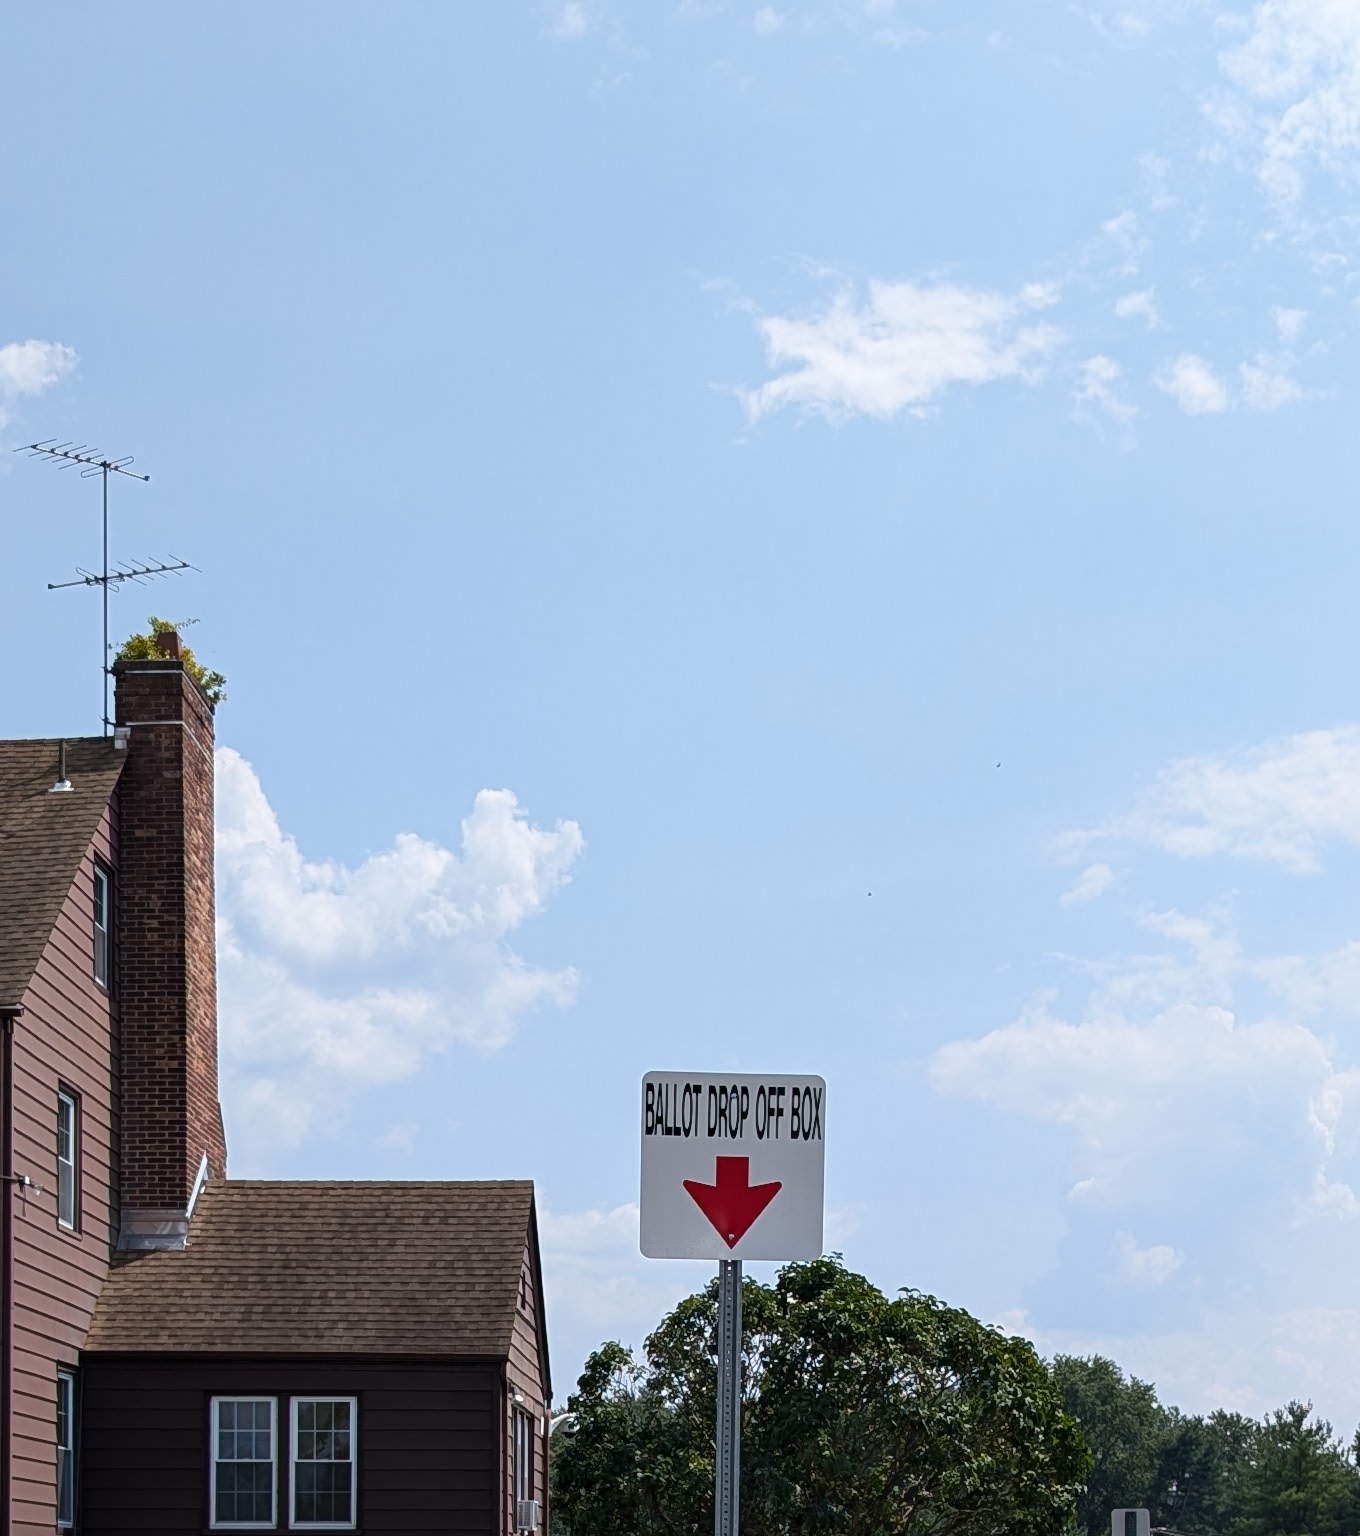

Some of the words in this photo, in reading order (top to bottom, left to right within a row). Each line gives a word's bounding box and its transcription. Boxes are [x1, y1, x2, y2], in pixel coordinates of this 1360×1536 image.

[645, 1082, 702, 1138] BALLOT
[707, 1084, 750, 1140] DROP
[755, 1085, 786, 1140] OFF
[790, 1086, 823, 1141] BOX
